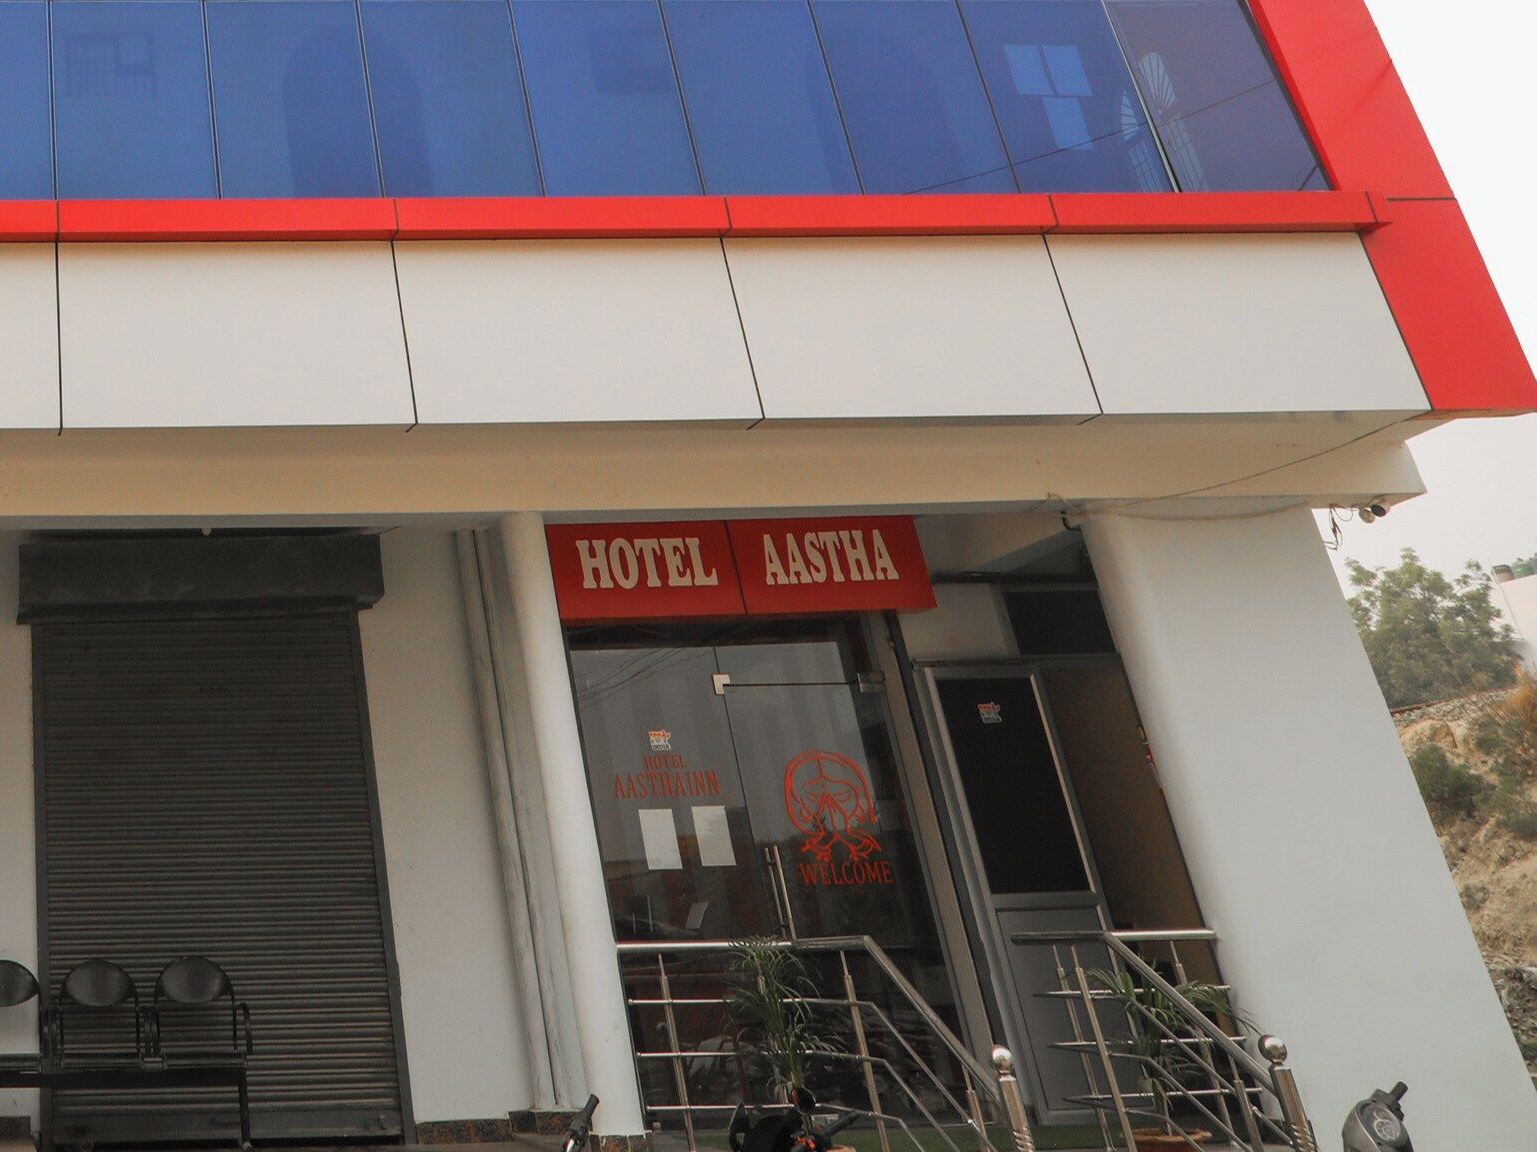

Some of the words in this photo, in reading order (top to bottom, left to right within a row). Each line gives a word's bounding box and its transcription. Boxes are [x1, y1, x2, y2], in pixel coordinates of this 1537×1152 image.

[575, 537, 719, 590] HOTEL
[764, 529, 900, 586] AASTHA
[643, 753, 688, 769] HOTEL
[798, 860, 894, 885] WELCOME
